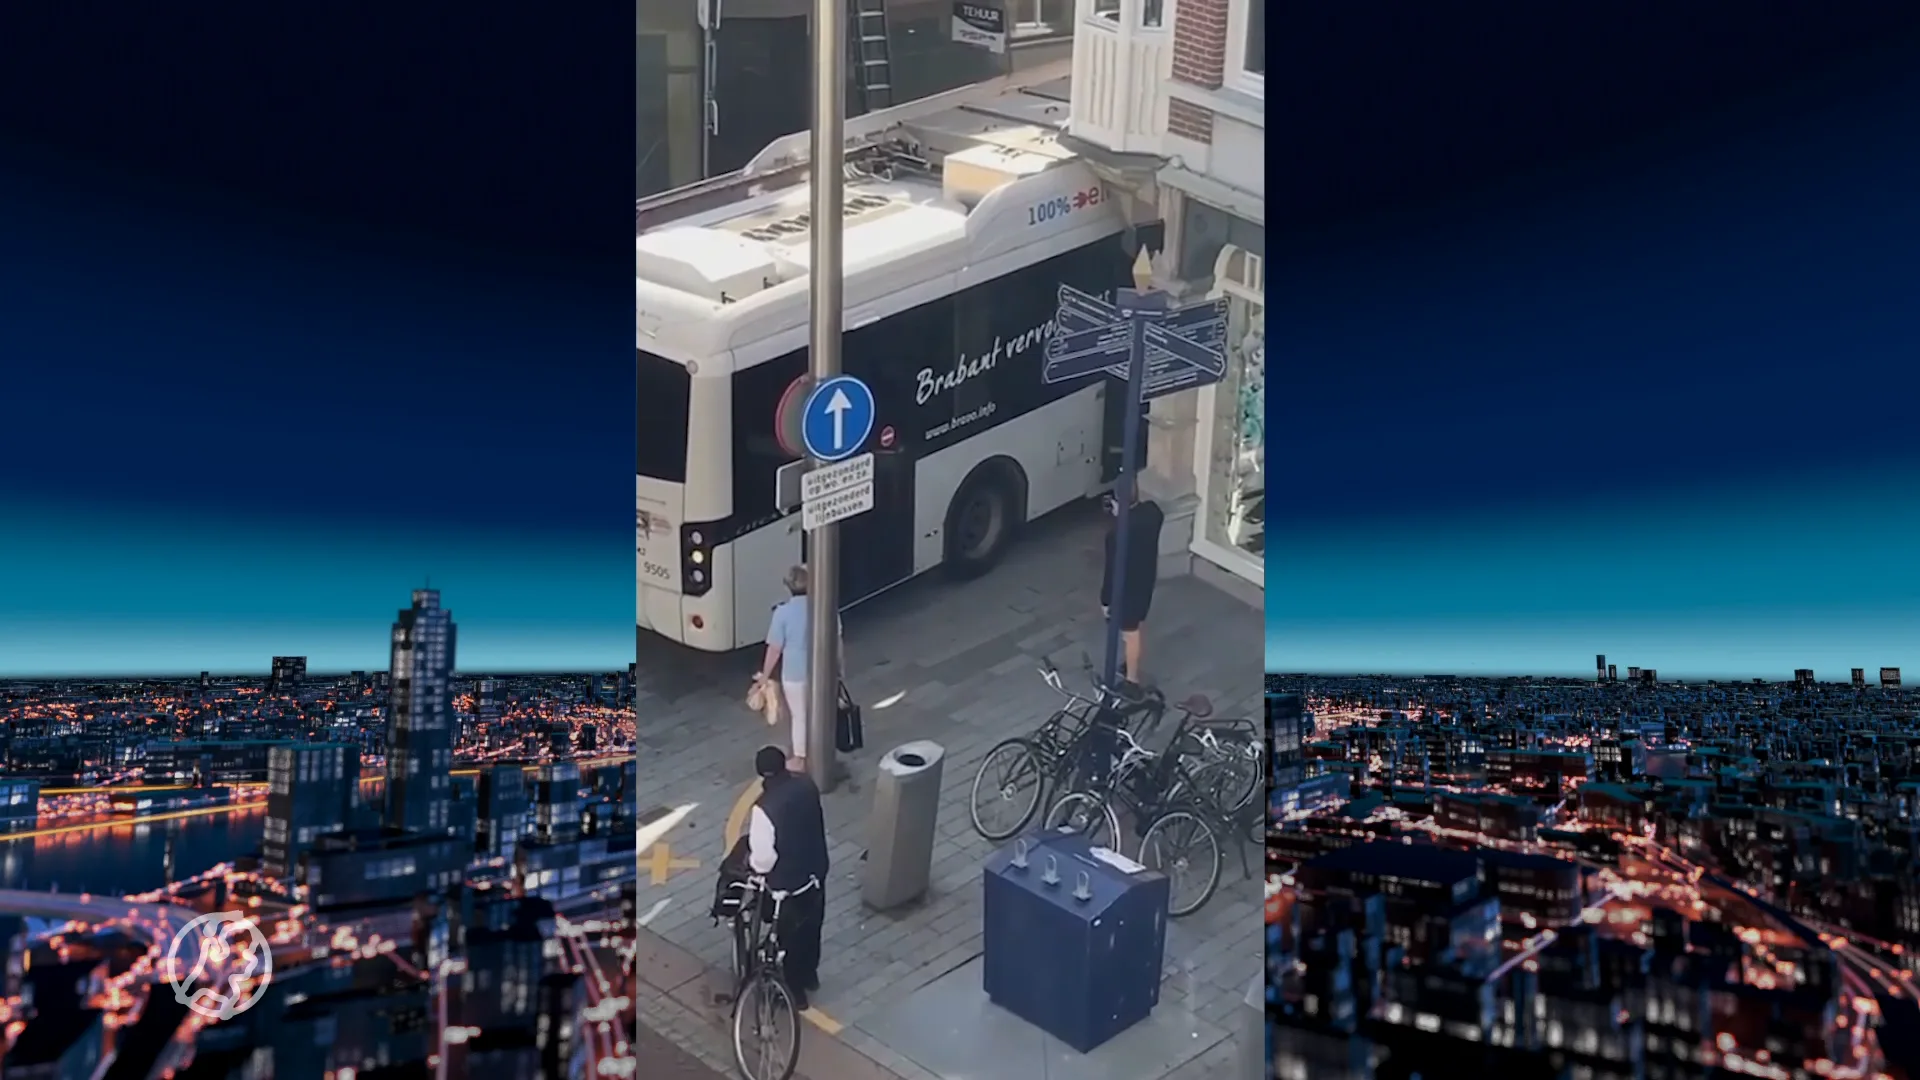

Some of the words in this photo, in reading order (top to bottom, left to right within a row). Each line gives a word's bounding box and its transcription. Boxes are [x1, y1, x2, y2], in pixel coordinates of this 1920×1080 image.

[1028, 195, 1071, 226] 100%
[916, 336, 1002, 405] Brabant
[1006, 319, 1058, 359] vervo
[925, 401, 997, 440] www.bravo.info
[807, 456, 871, 487] uitgezonderd
[808, 484, 822, 497] op
[842, 474, 855, 485] en
[807, 484, 871, 515] uitgezonderd
[815, 500, 864, 524] lijnbussen
[643, 560, 672, 581] 9505
